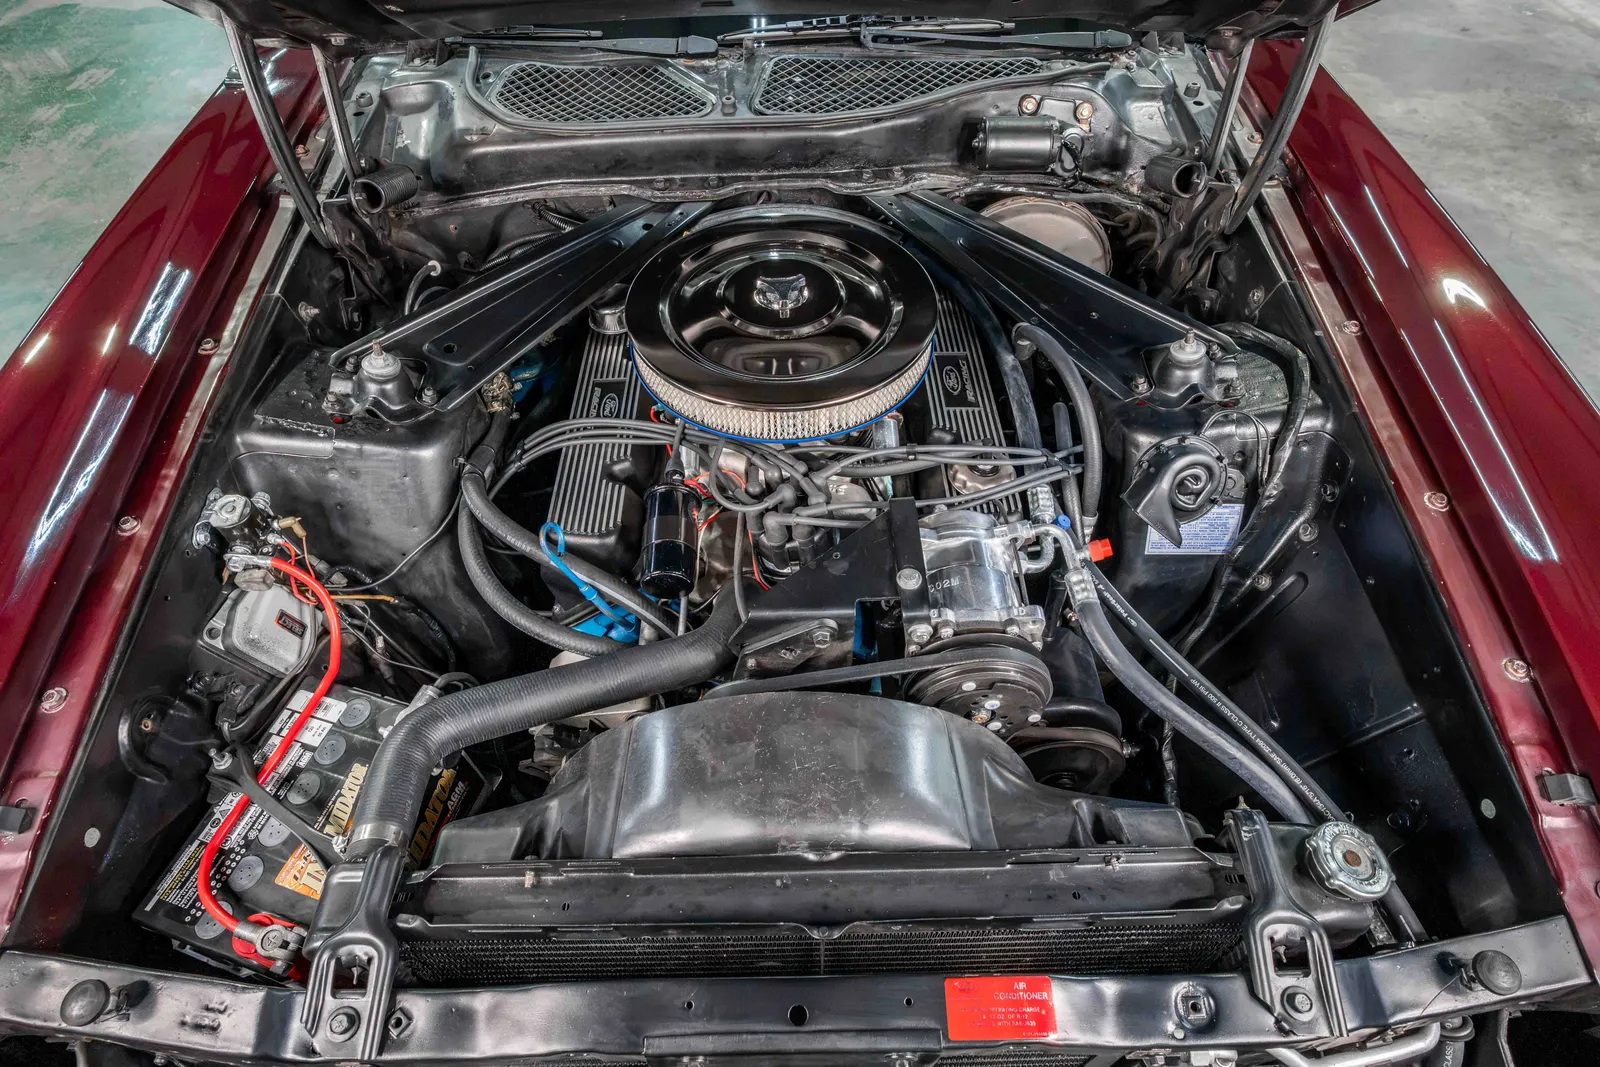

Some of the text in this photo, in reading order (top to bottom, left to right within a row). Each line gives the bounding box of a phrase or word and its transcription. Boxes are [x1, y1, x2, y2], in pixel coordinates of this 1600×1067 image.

[959, 360, 976, 402] RACING
[604, 399, 617, 417] Ford
[278, 615, 304, 635] SELECT
[1190, 677, 1200, 686] WP
[1198, 685, 1208, 694] PSI
[1207, 693, 1217, 703] 500
[1220, 705, 1238, 721] CLASS
[1241, 725, 1256, 739] TYPE
[1255, 738, 1271, 752] J2064
[1270, 752, 1282, 764] SAE
[447, 781, 466, 811] AGM
[1014, 982, 1026, 990] AIR
[993, 992, 1048, 1000] CONDITIONER
